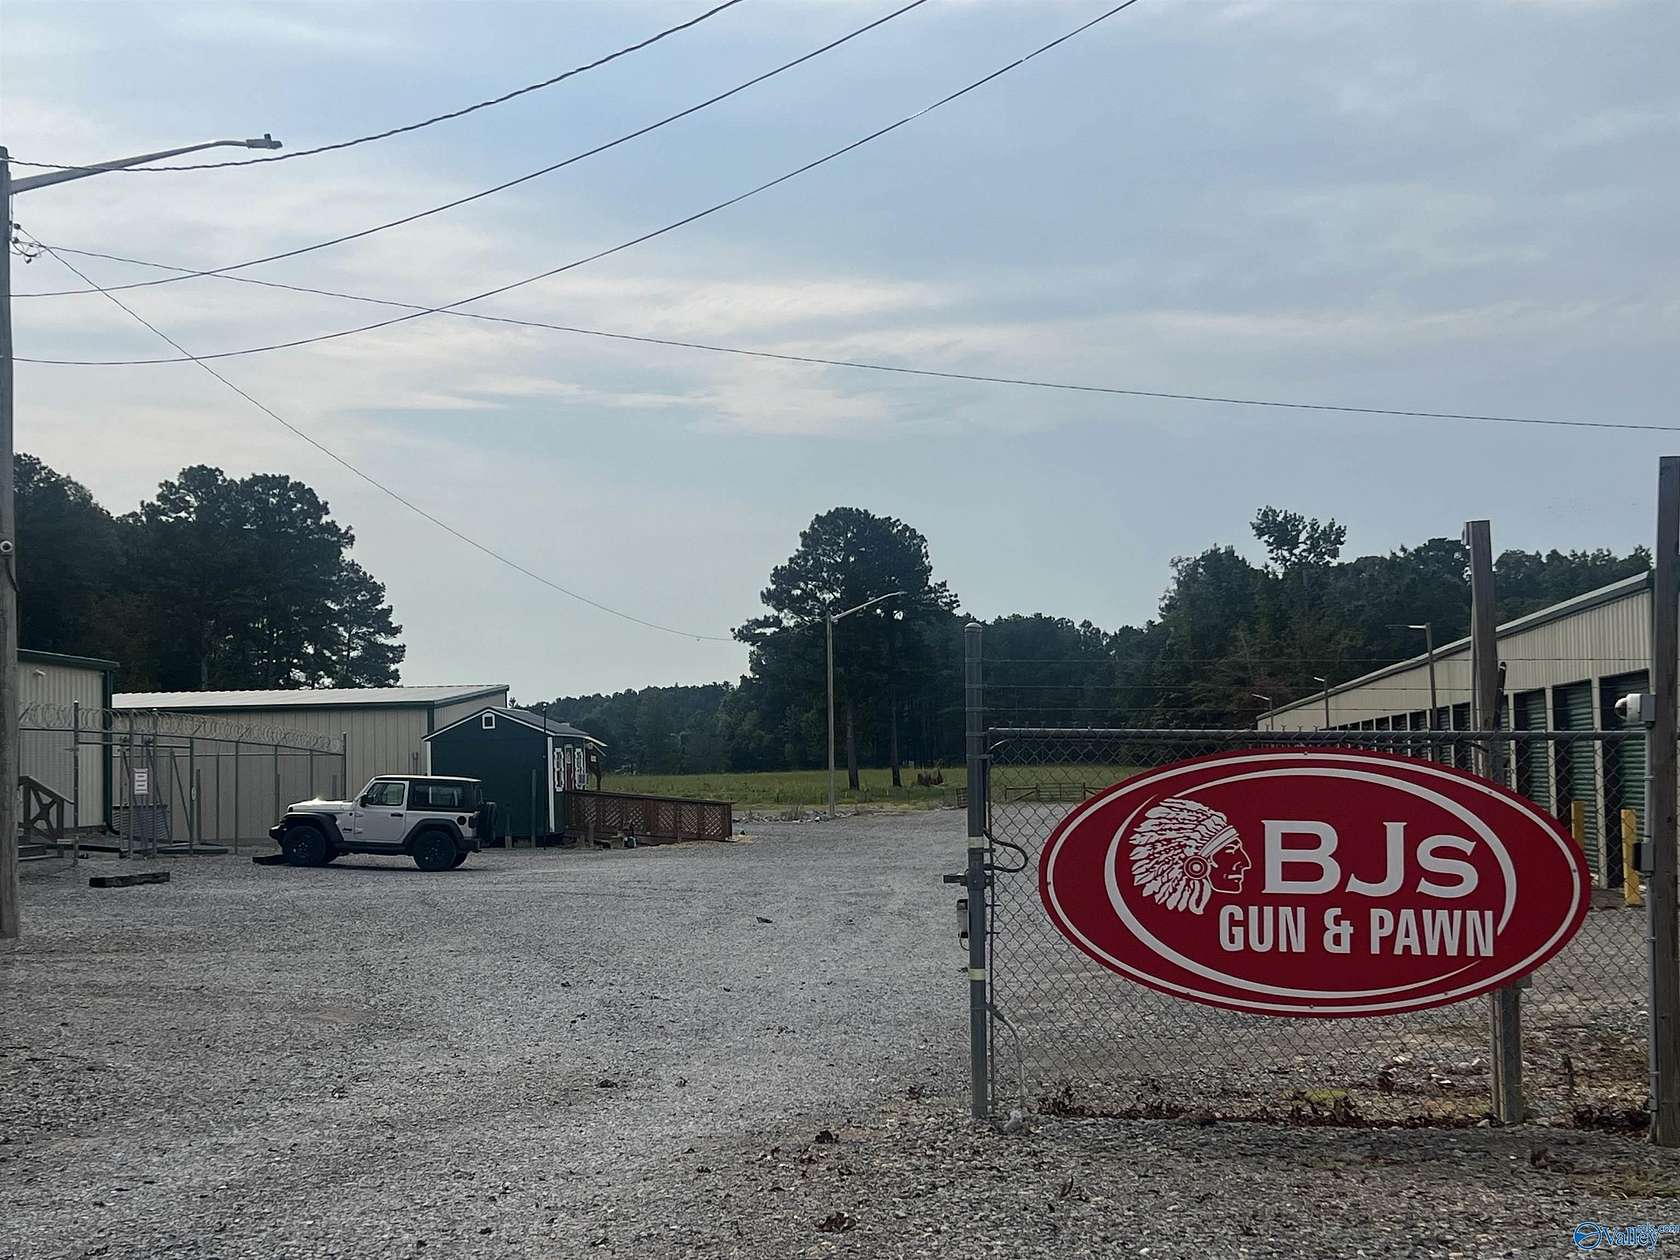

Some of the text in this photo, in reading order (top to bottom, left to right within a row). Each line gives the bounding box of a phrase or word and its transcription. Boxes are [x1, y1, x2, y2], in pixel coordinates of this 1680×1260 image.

[1262, 820, 1478, 897] BJs
[1219, 905, 1494, 956] GUN & PAWN
